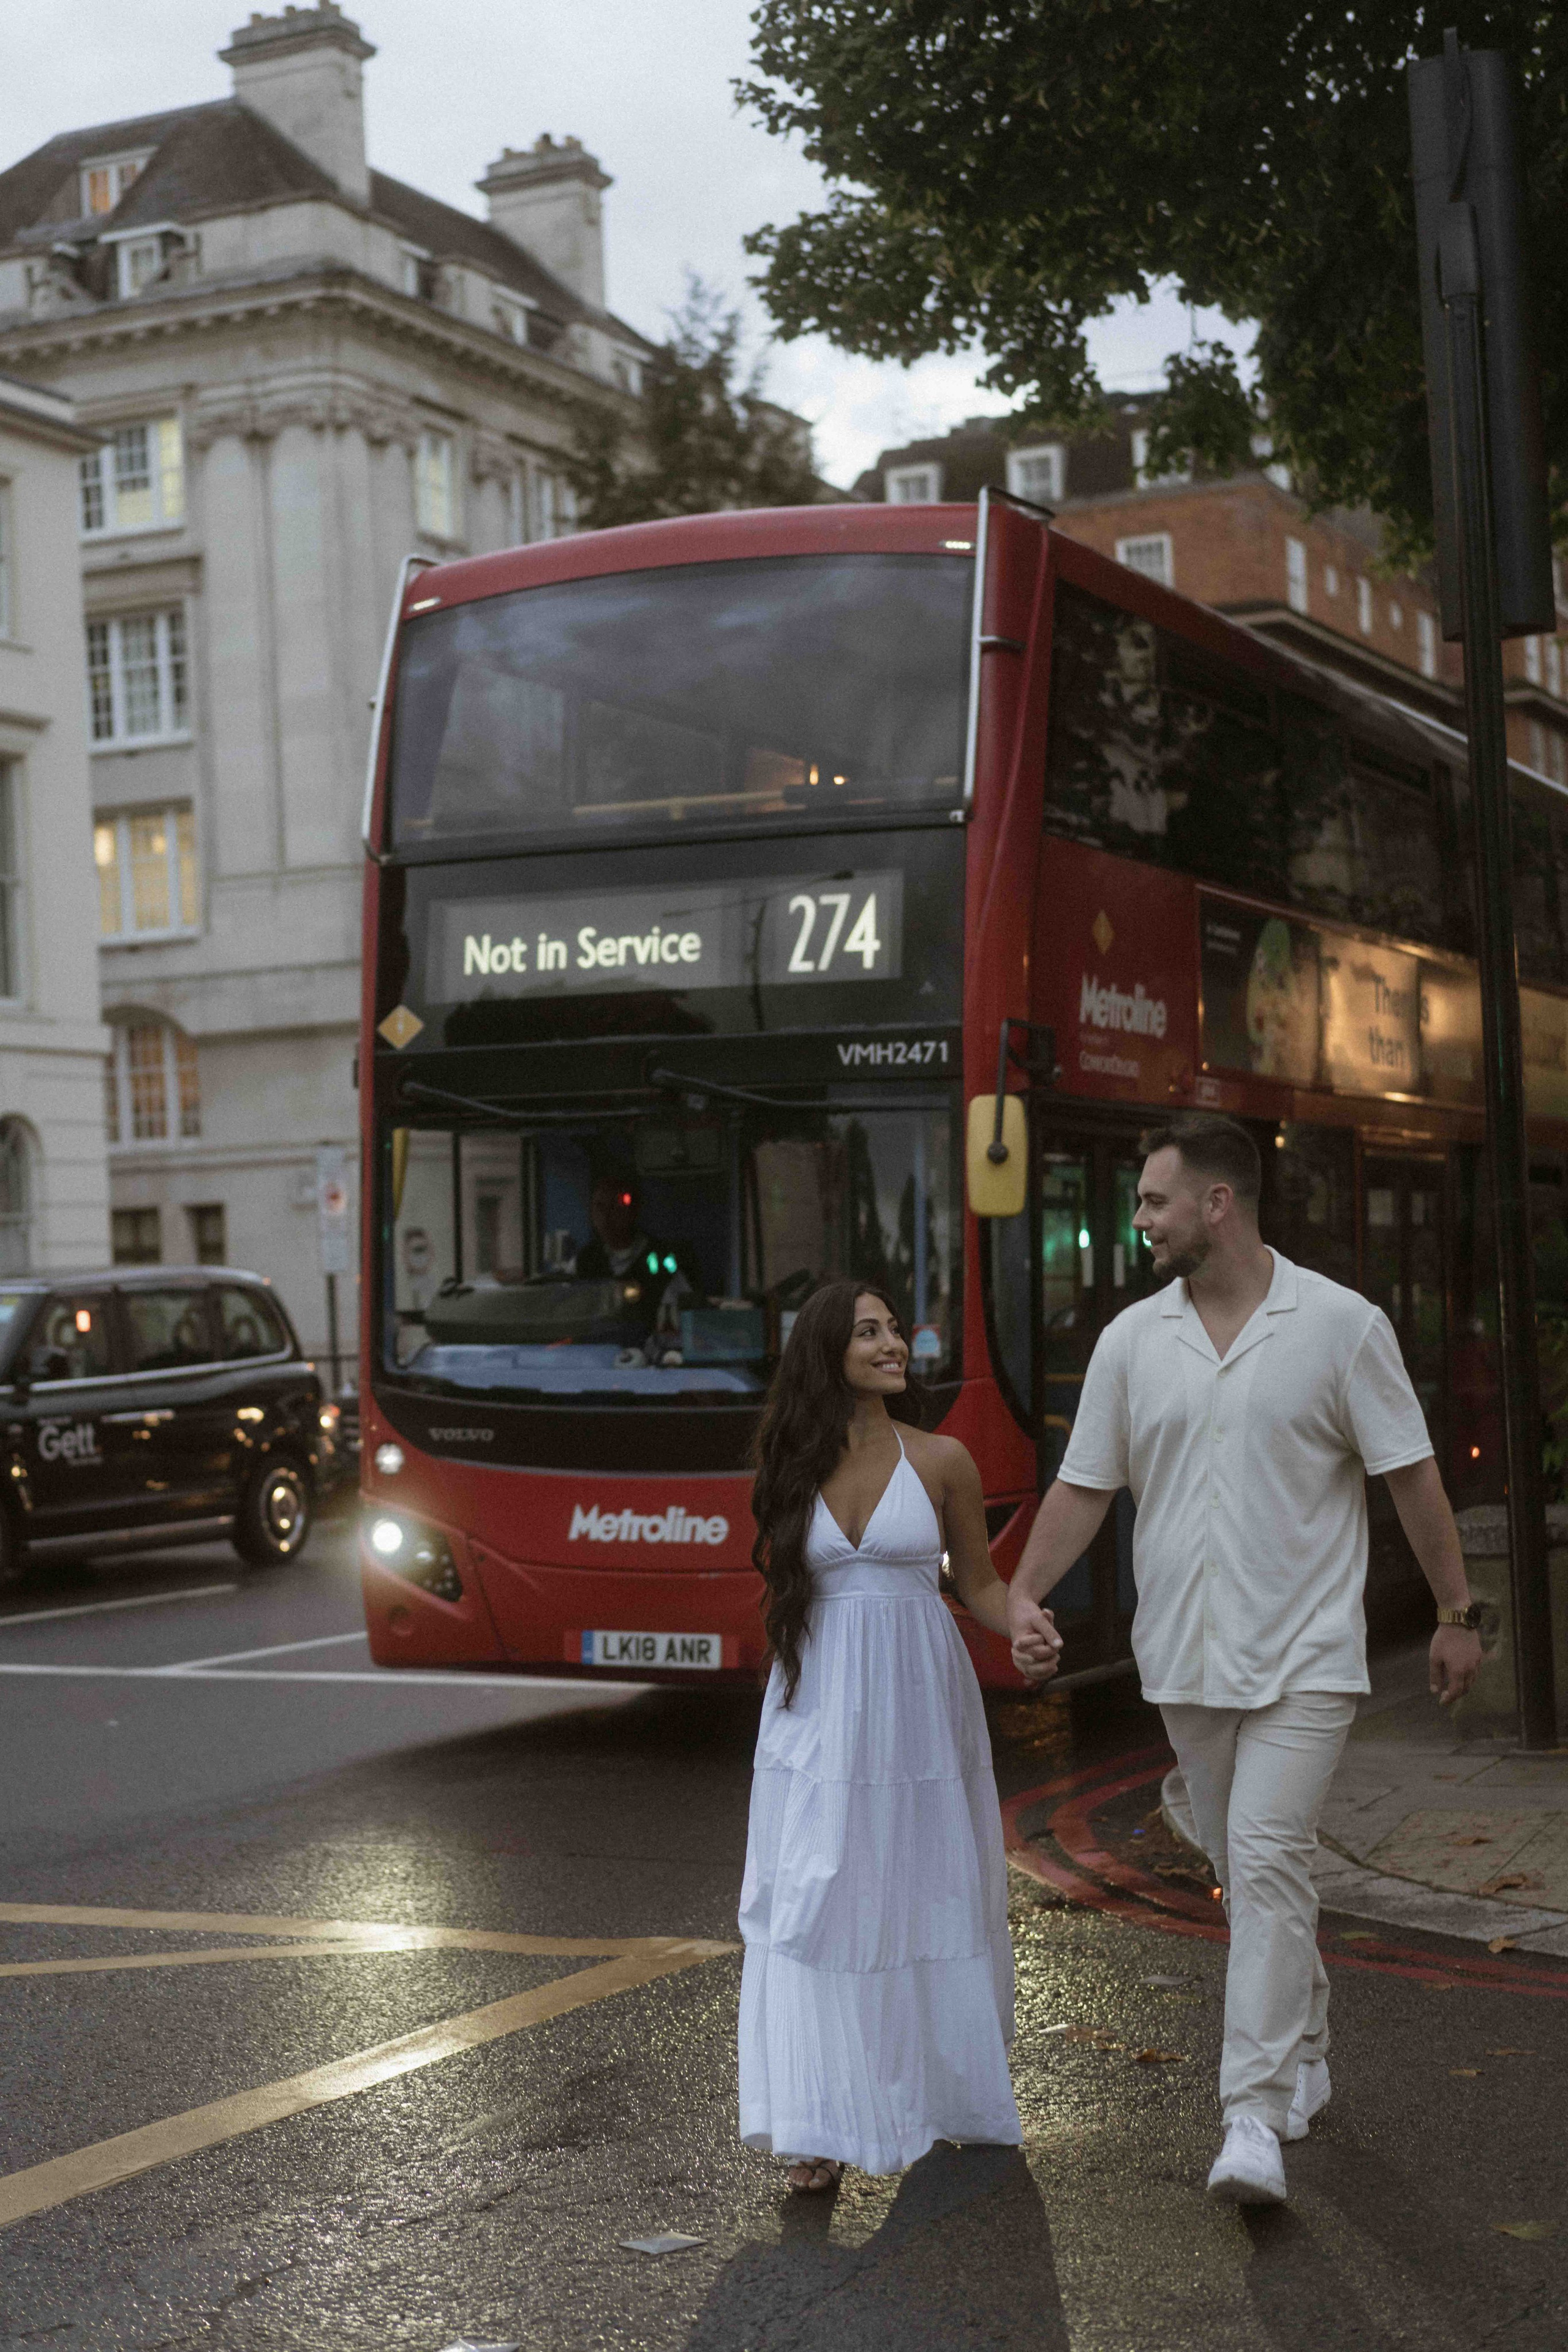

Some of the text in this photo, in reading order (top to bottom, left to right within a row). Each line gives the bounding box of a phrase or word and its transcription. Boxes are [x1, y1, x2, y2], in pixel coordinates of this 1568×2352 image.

[464, 925, 701, 975] Not in Service
[788, 892, 881, 973] 274
[1079, 973, 1167, 1039] Metroline
[837, 1041, 949, 1066] VMH2471
[429, 1427, 494, 1442] VOLVO
[568, 1504, 729, 1545] Metroline
[603, 1635, 711, 1664] LK18 ANR
